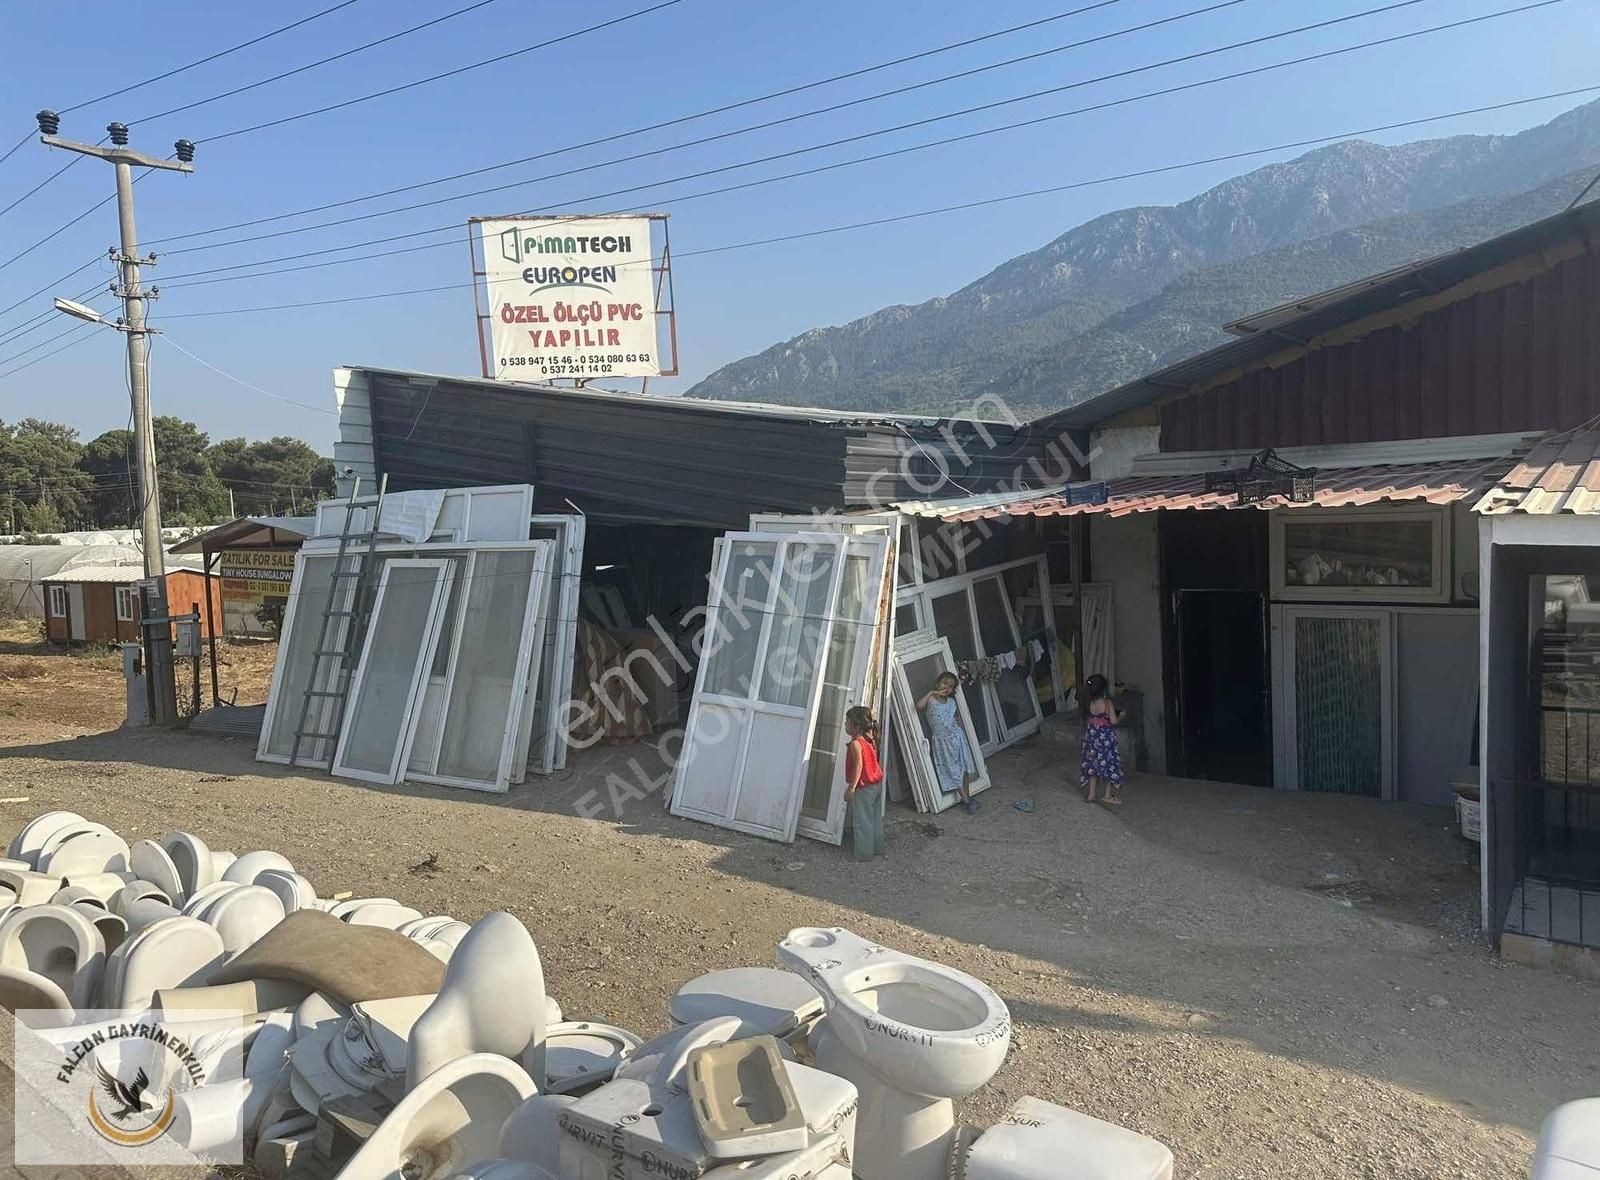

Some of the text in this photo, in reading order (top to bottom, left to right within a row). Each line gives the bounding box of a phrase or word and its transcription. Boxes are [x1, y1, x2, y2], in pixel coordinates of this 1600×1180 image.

[522, 266, 616, 284] EUROPEN
[501, 301, 643, 326] ÖZEL ÖLÇÜ PVC
[528, 328, 620, 348] YAPILIR
[501, 358, 507, 366] 0
[509, 357, 526, 366] 538
[528, 356, 545, 366] 947
[548, 356, 559, 365] 15
[561, 355, 572, 365] 46
[580, 355, 586, 364] 0
[589, 355, 605, 364] 534
[607, 354, 624, 363] 080
[626, 354, 637, 363] 63
[639, 353, 650, 362] 63
[541, 364, 613, 374] 0 537 241 14 02
[222, 552, 295, 567] SATILIK FOR SALE
[223, 567, 236, 577] TINY
[236, 567, 257, 578] HOUSE
